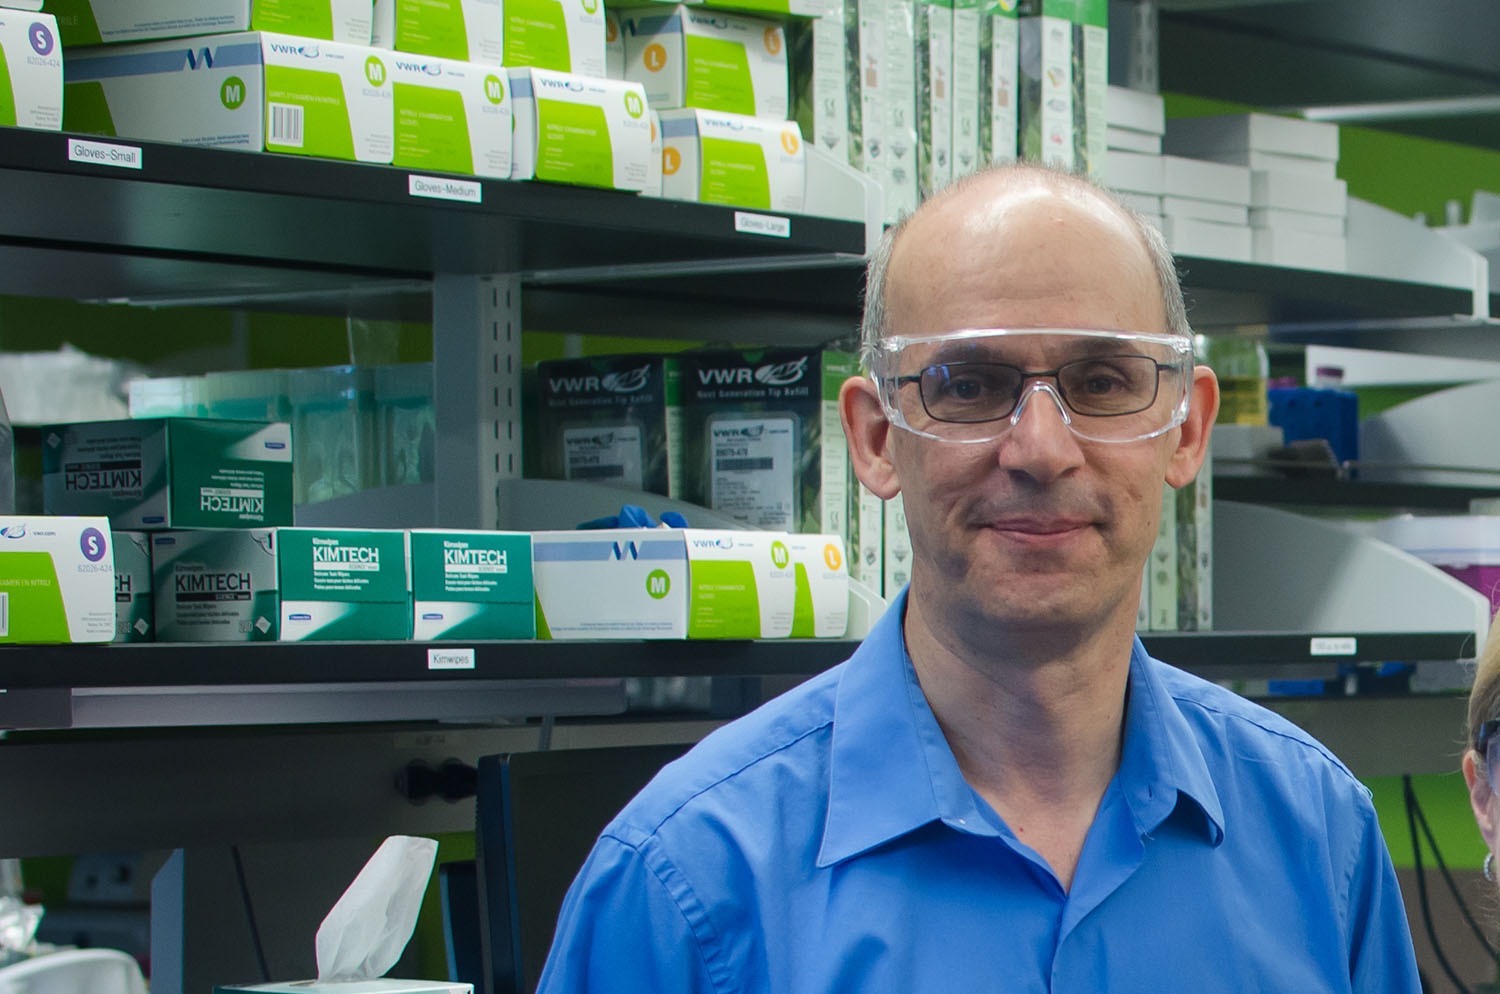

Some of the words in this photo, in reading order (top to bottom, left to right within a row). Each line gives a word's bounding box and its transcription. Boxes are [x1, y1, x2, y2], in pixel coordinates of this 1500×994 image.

[36, 30, 47, 50] S
[271, 43, 298, 56] VWR
[651, 50, 659, 67] L
[368, 62, 385, 81] M
[395, 61, 422, 74] VWR
[487, 80, 501, 99] M
[540, 78, 566, 89] VWR
[225, 84, 241, 103] M
[627, 96, 641, 115] M
[74, 144, 136, 163] Gloves-Small
[665, 153, 674, 171] L
[415, 180, 477, 198] Gloves-Medium
[740, 216, 786, 233] Gloves-Large
[550, 376, 600, 393] VWR
[698, 368, 753, 385] VWR
[65, 470, 142, 491] KIMTECH
[200, 496, 265, 513] KIMTECH
[87, 535, 99, 556] S
[693, 539, 716, 549] VWR
[312, 546, 380, 562] KIMTECH
[443, 549, 507, 565] KIMTECH
[774, 546, 787, 564] M
[175, 573, 251, 592] KIMTECH
[650, 576, 666, 594] M
[433, 654, 470, 665] Kimwipes
